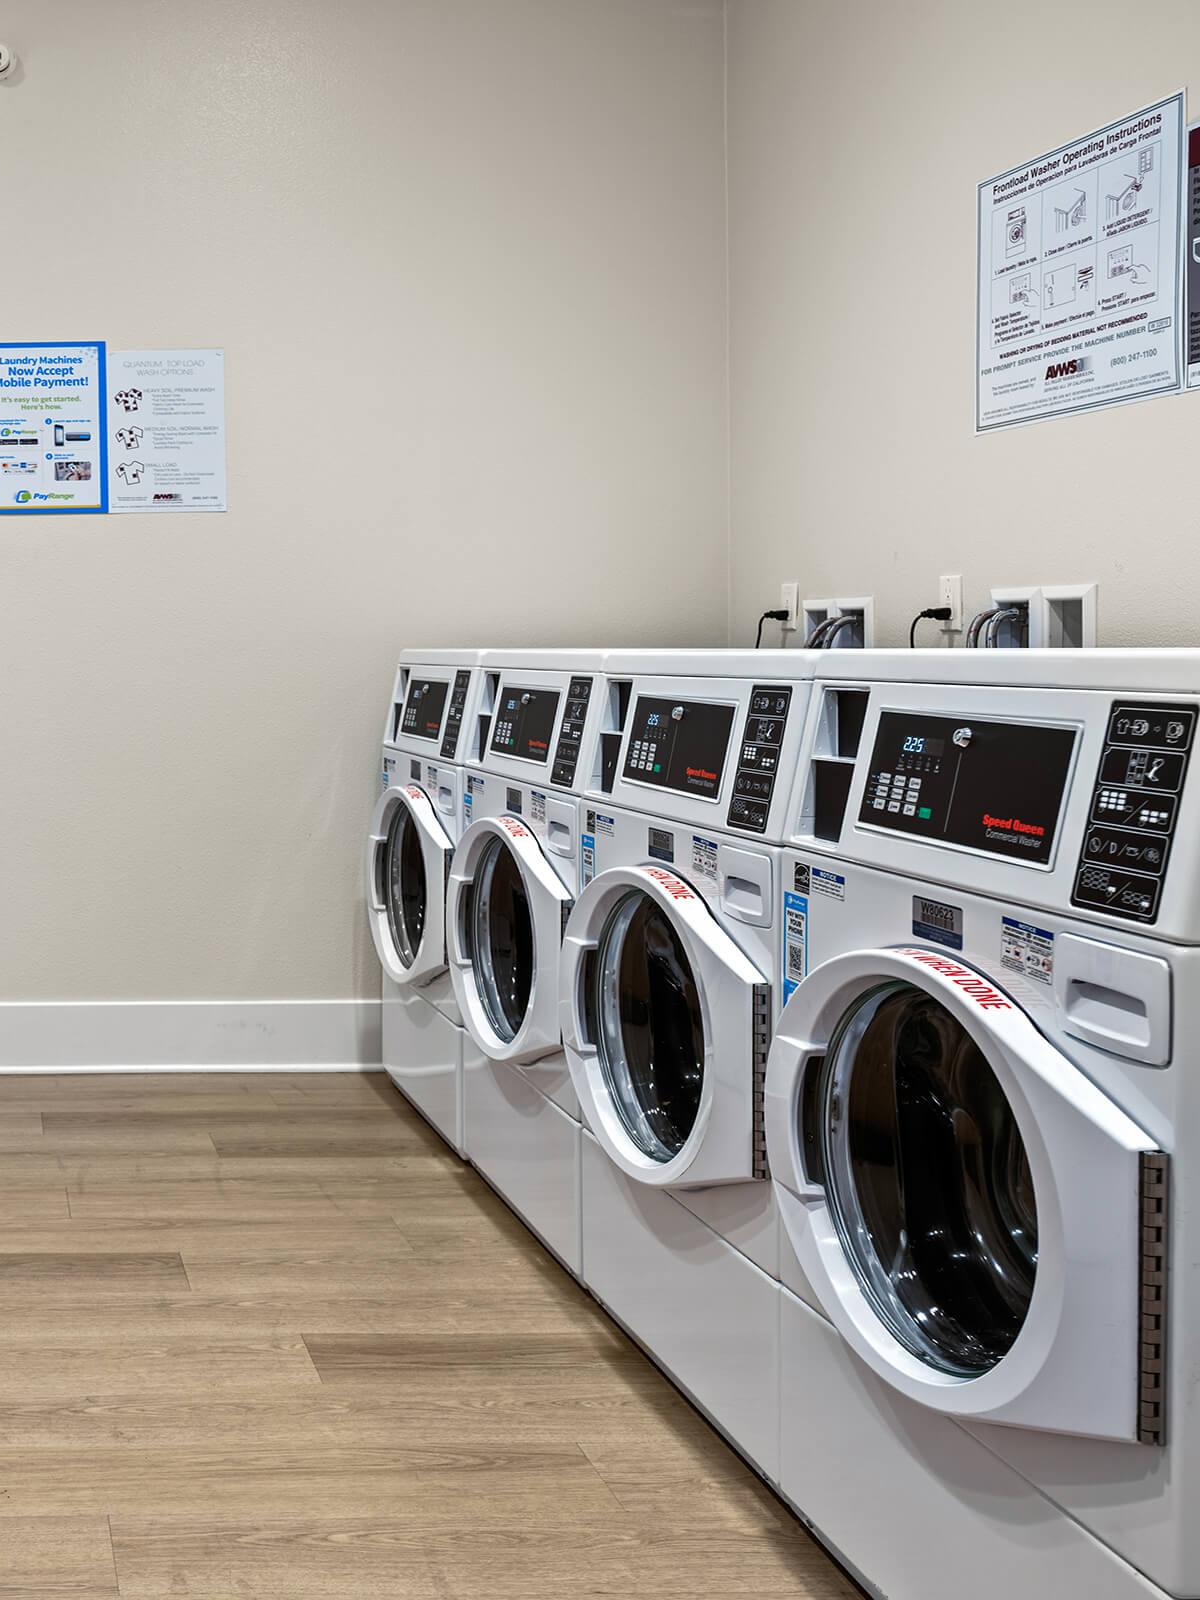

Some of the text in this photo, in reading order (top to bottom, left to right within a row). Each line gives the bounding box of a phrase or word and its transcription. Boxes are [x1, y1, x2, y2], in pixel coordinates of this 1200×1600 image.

[992, 113, 1162, 195] Frontload Washer Operating Instructions
[992, 126, 1162, 205] Instrucciones de Operacion para Lavadoras de Carga Frontal
[1000, 349, 1020, 360] WASHING
[1027, 344, 1044, 352] DRYING
[1044, 340, 1050, 348] OF
[1051, 334, 1072, 345] BEDDING
[1072, 327, 1096, 339] MATERIAL
[1096, 323, 1106, 332] NOT
[1108, 312, 1148, 328] RECOMMENDED
[981, 368, 992, 376] FOR
[993, 361, 1016, 373] PROMPT
[1017, 354, 1041, 366] SERVICE
[1043, 346, 1070, 359] PROVIDE
[1071, 342, 1084, 352] THE
[1084, 334, 1115, 348] MACHINE
[1116, 325, 1146, 339] NUMBER
[1110, 348, 1158, 368] (800) 247-1100
[0, 356, 82, 366] Laundry Machines
[1045, 359, 1078, 380] AVWS
[8, 366, 74, 377] Now Accept
[34, 377, 89, 388] Payment!
[982, 814, 1044, 836] Speed Queen
[985, 828, 1041, 848] Commercial Washer
[820, 872, 836, 881] NOTICE
[660, 880, 695, 899] DONE
[914, 952, 972, 977] WHEN
[953, 979, 1012, 1010] DONE
